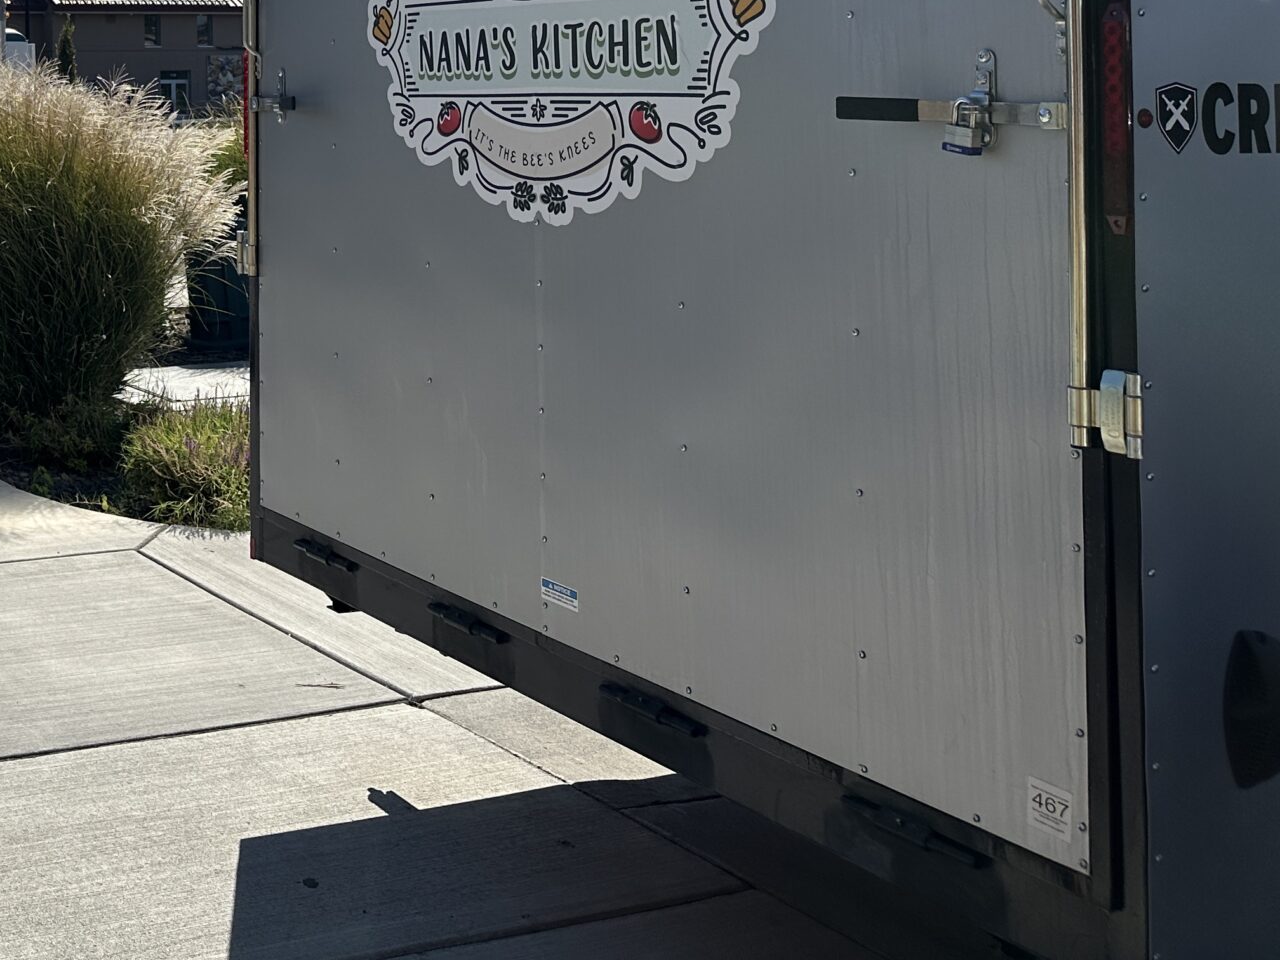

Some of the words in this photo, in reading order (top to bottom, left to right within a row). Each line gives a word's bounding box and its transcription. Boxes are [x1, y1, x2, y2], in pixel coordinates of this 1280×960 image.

[419, 26, 517, 74] NANA'S
[531, 14, 680, 73] KITCHEN
[474, 128, 494, 152] IT'S
[498, 144, 517, 164] THE
[522, 152, 554, 167] BEE'S
[558, 131, 596, 163] KNEES
[1031, 793, 1069, 818] 467
